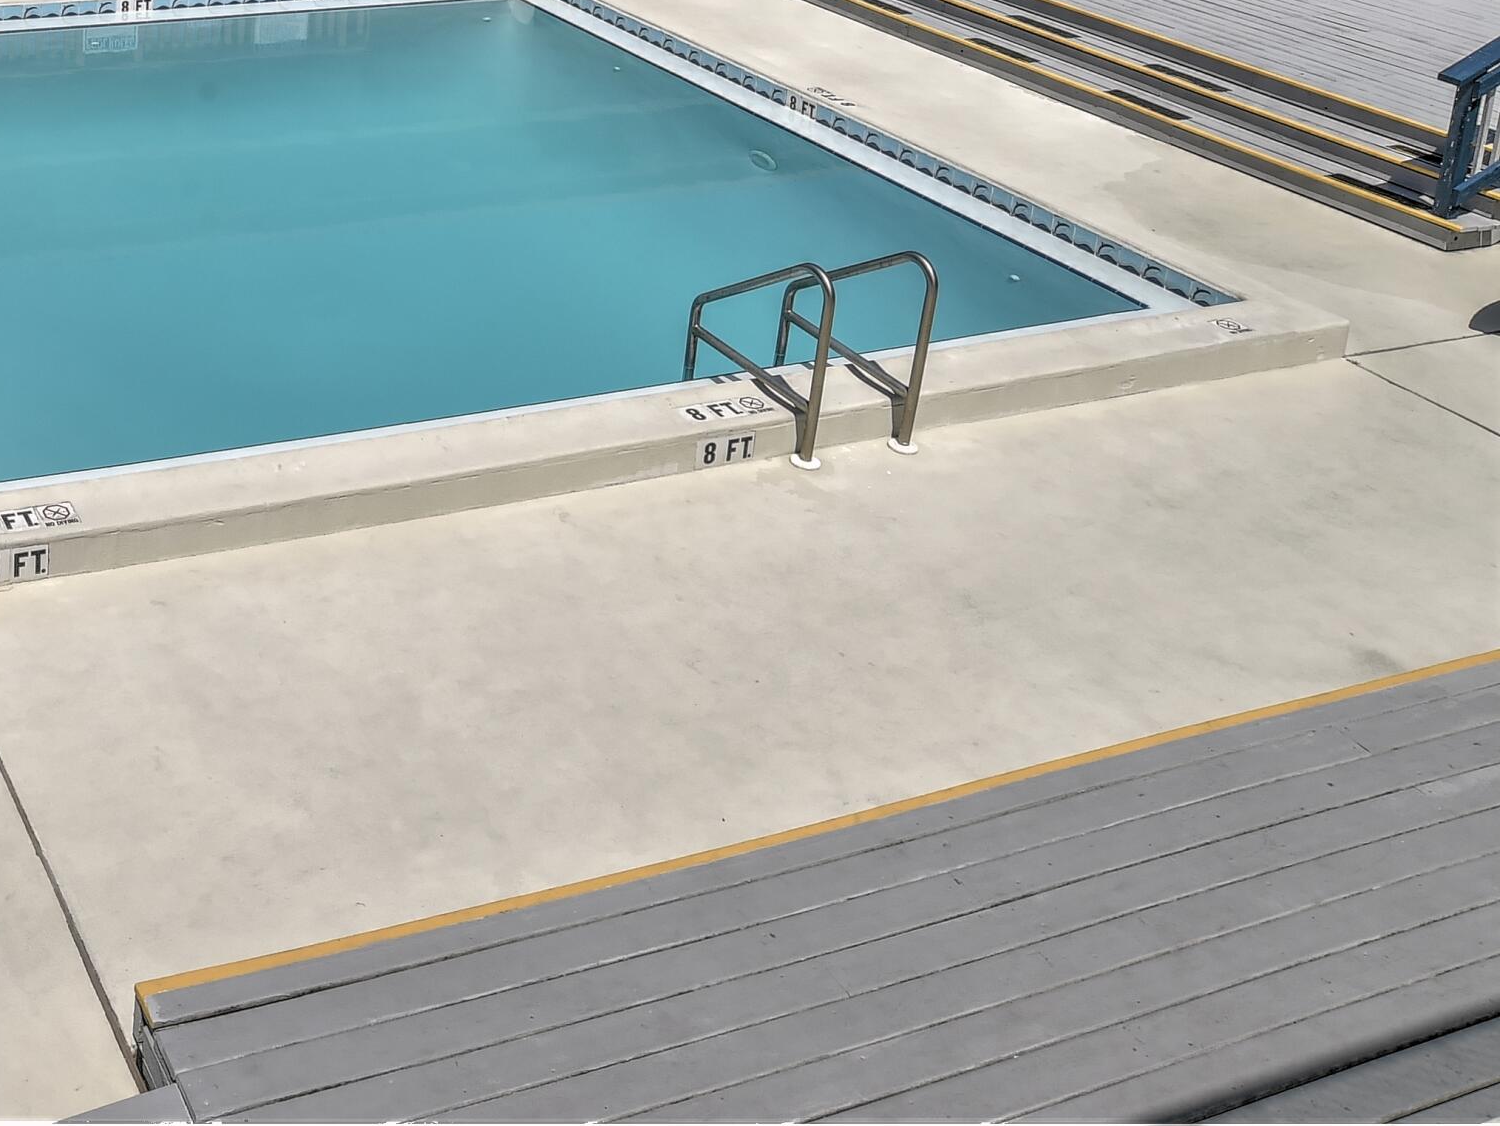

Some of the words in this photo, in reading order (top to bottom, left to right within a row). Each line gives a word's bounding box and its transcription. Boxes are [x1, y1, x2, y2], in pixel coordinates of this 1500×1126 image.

[121, 0, 129, 12] 8
[789, 95, 797, 110] 8
[685, 408, 707, 421] 8
[707, 401, 743, 417] FT.
[703, 442, 717, 464] 8
[726, 436, 753, 462] FT.
[1, 510, 40, 530] FT.
[14, 549, 46, 578] FT.
